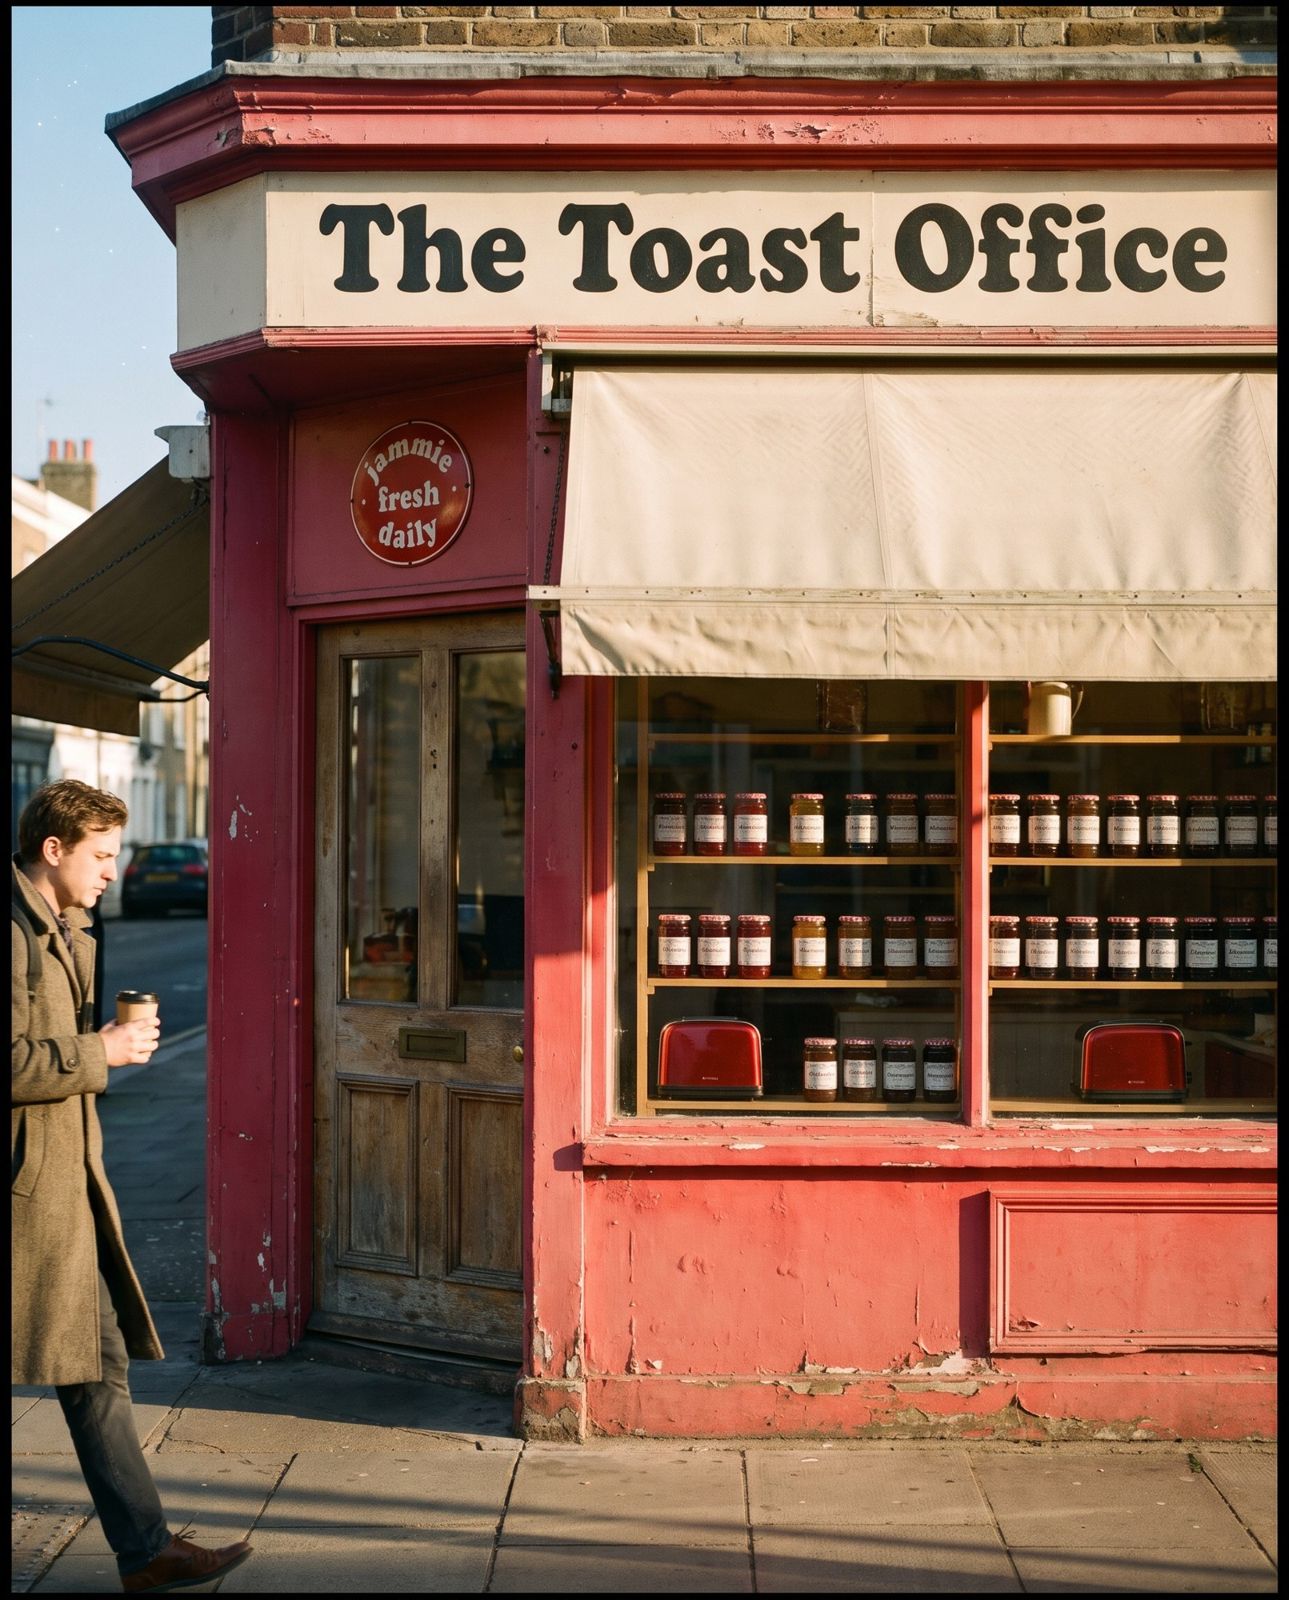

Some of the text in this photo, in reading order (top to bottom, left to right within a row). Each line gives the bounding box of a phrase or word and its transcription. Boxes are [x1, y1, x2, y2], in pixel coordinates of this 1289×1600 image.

[319, 203, 1228, 293] The Toast Office
[364, 437, 453, 487] jammie
[378, 480, 440, 513] fresh
[378, 518, 437, 549] daily
